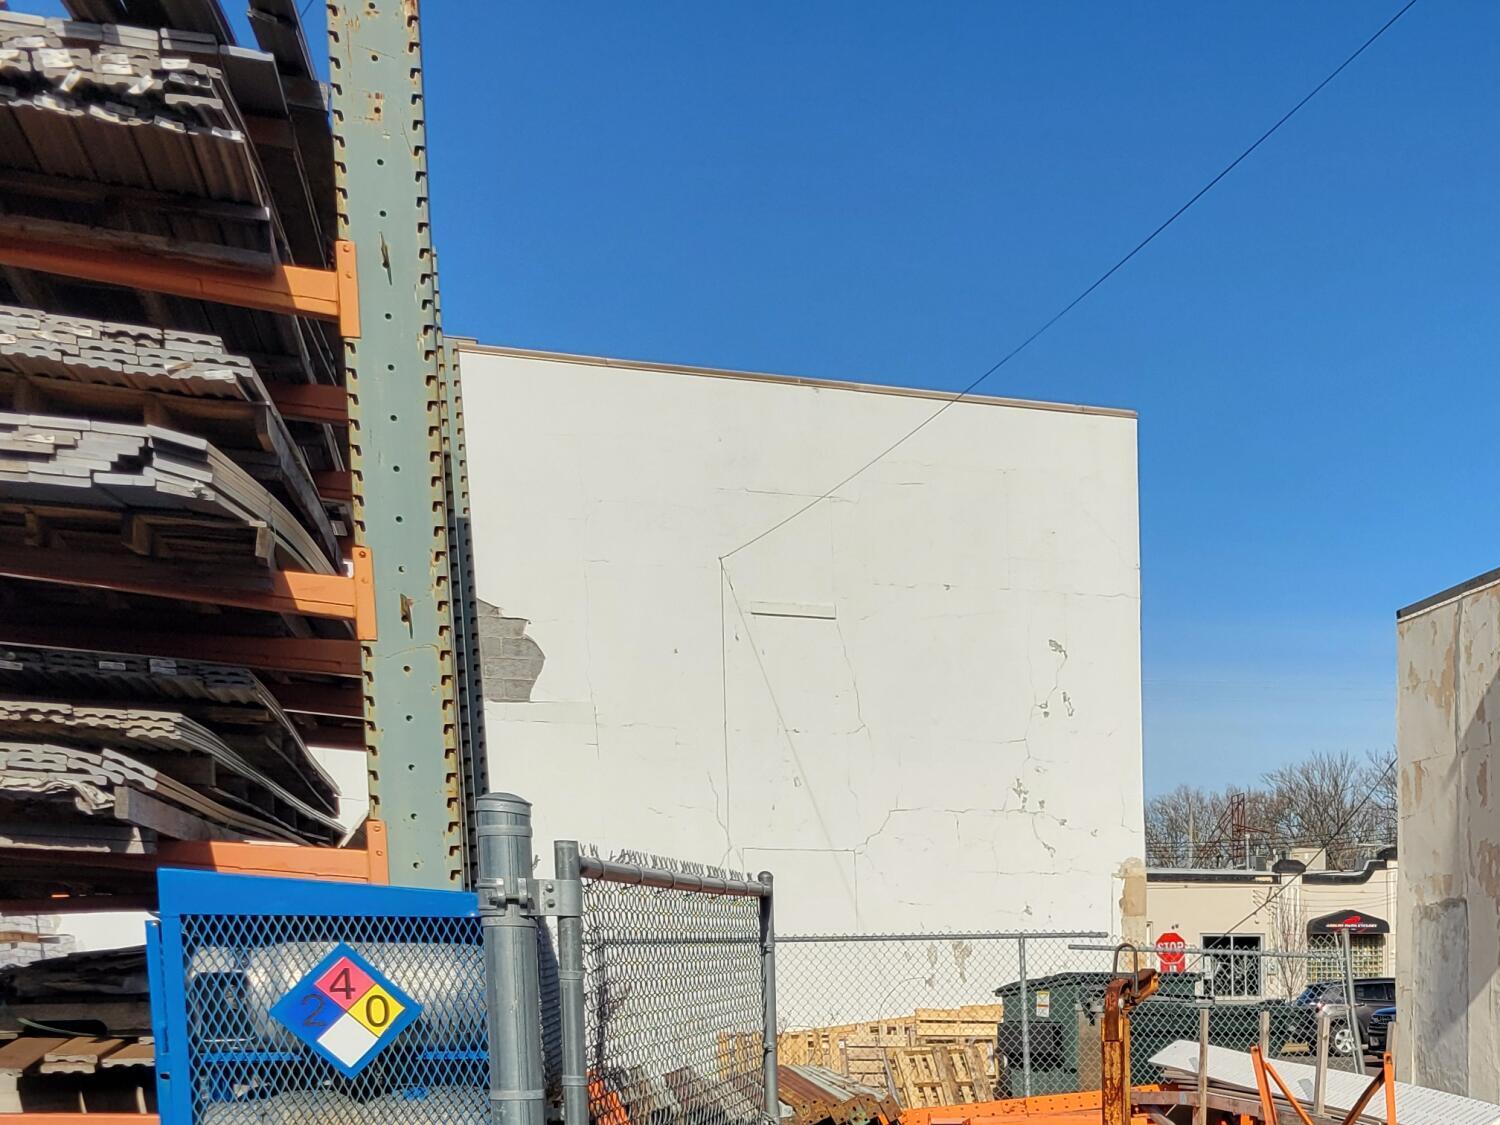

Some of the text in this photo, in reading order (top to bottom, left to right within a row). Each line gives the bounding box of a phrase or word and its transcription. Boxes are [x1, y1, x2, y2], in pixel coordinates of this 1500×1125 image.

[329, 967, 356, 1000] 4
[302, 993, 327, 1027] 2
[365, 994, 391, 1028] 0
